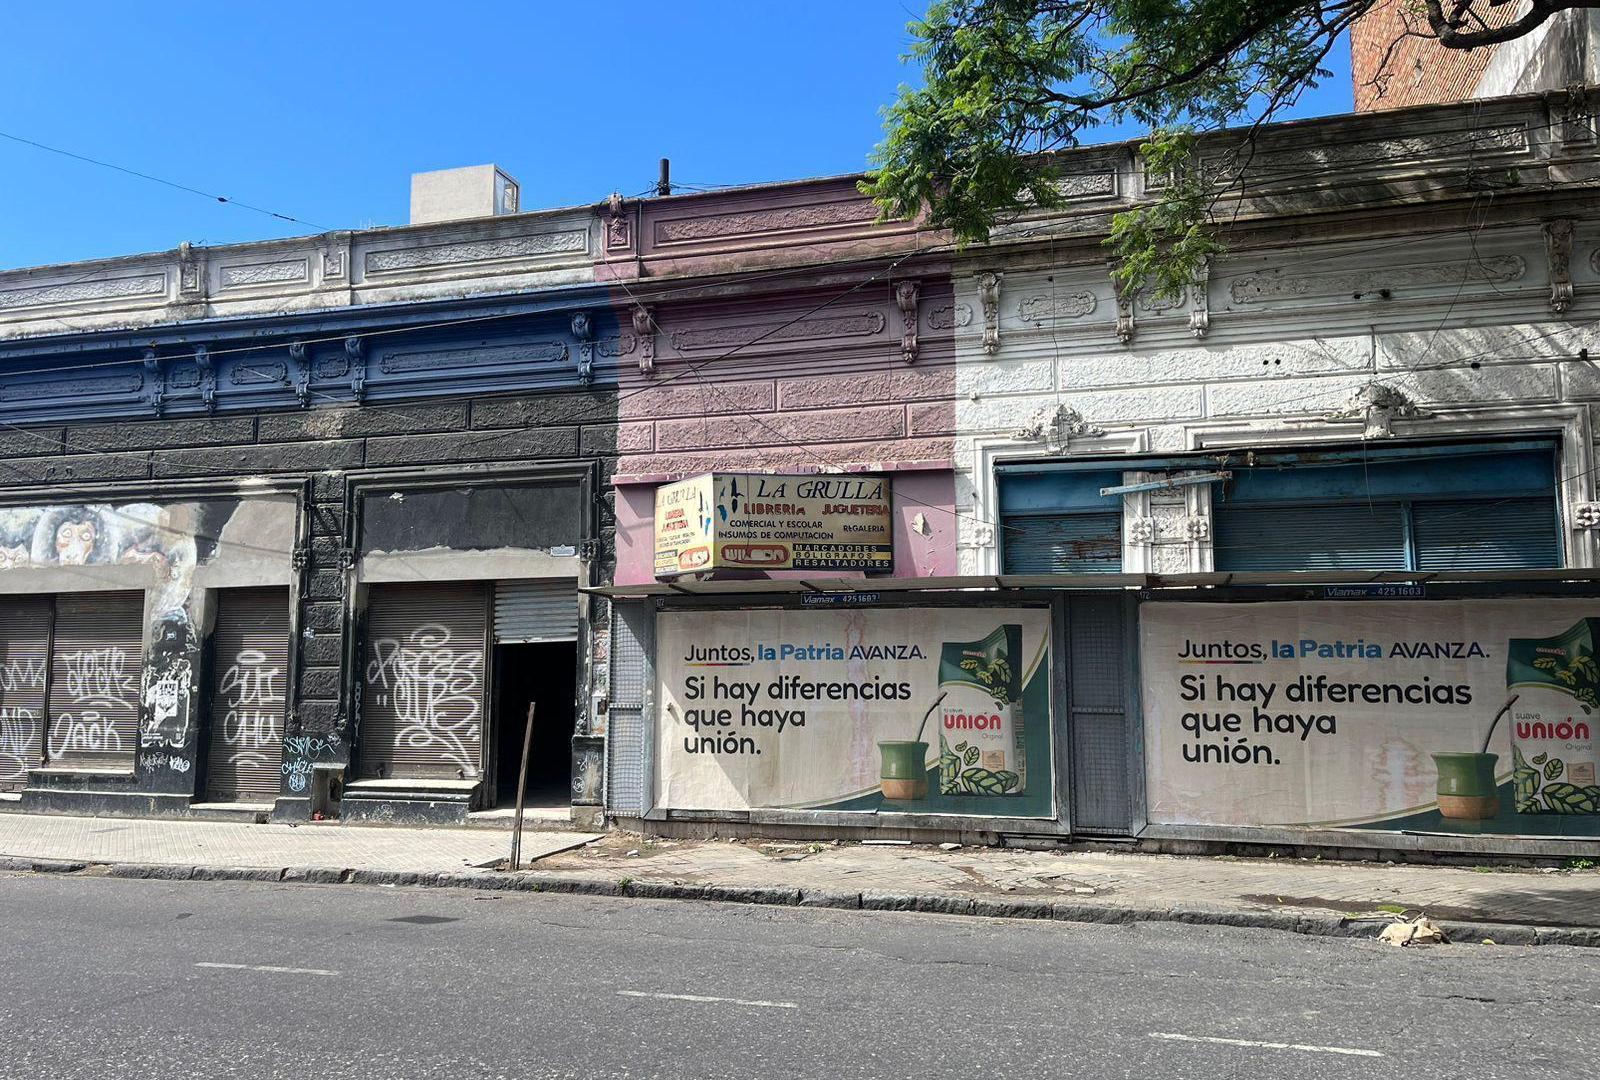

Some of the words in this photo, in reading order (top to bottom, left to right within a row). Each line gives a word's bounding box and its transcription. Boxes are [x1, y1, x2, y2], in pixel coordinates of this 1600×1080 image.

[757, 479, 786, 498] LA
[797, 480, 883, 499] GRULLA
[743, 503, 806, 516] LIBRERIA
[822, 503, 890, 516] JUGUETERIA
[729, 520, 777, 528] COMERCIAL
[786, 521, 823, 529] ESCOLAR
[843, 525, 885, 533] REGALERIA
[718, 531, 758, 539] INSUMOS
[760, 531, 772, 539] DE
[774, 531, 834, 540] COMPUTACION
[795, 544, 877, 552] MARCADORES
[795, 551, 872, 559] BOLIGRAFOS
[795, 559, 889, 567] RESALTADORES
[803, 595, 835, 604] Viamax
[1327, 587, 1367, 597] Viamax
[684, 644, 755, 663] Juntos,
[758, 643, 776, 660] la
[780, 643, 844, 661] Patria
[849, 645, 927, 660] AVANZA.
[1178, 639, 1268, 661] Juntos,
[1271, 639, 1295, 658] la
[1300, 639, 1382, 659] Patria
[1389, 642, 1490, 659] AVANZA.
[684, 676, 705, 700] Si
[713, 676, 761, 706] hay
[767, 675, 911, 701] diferencias
[1180, 675, 1205, 701] Si
[1217, 675, 1276, 709] hay
[1285, 675, 1472, 705] diferencias
[684, 708, 732, 732] que
[741, 703, 806, 733] haya
[1181, 710, 1241, 738] que
[1252, 706, 1336, 741] haya
[1514, 712, 1541, 720] suave
[1516, 717, 1590, 740] unión
[684, 730, 762, 755] unión.
[1182, 737, 1281, 765] unión.
